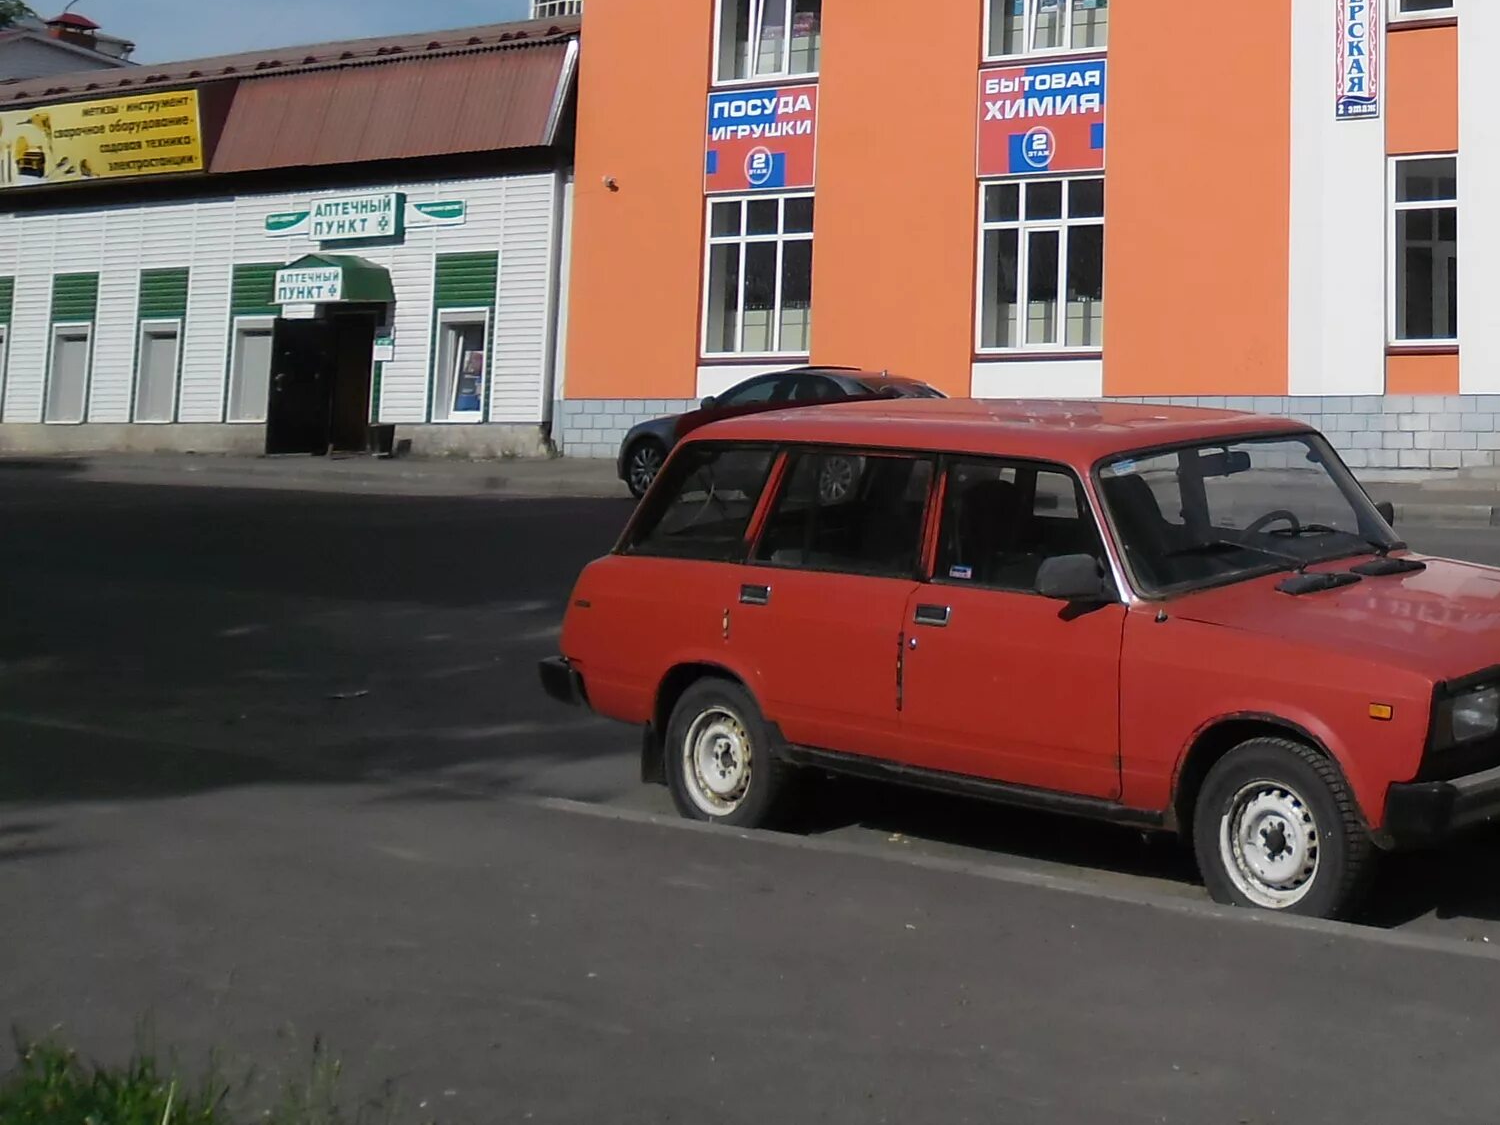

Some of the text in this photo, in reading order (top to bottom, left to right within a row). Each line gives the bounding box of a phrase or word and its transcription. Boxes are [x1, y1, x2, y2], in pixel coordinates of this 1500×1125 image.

[984, 69, 1101, 96] БЫТОВАЯ
[712, 94, 812, 120] ПОСУДА
[984, 92, 1101, 121] ХИМИЯ
[711, 120, 812, 142] ИГРУШКИ
[1032, 134, 1048, 150] 2
[752, 153, 766, 168] 2
[314, 195, 392, 218] АПТЕЧНЫЙ
[313, 218, 368, 236] ПУНКТ
[279, 270, 340, 284] АПТЕЧНЫЙ
[278, 285, 324, 300] ПУНКТ
